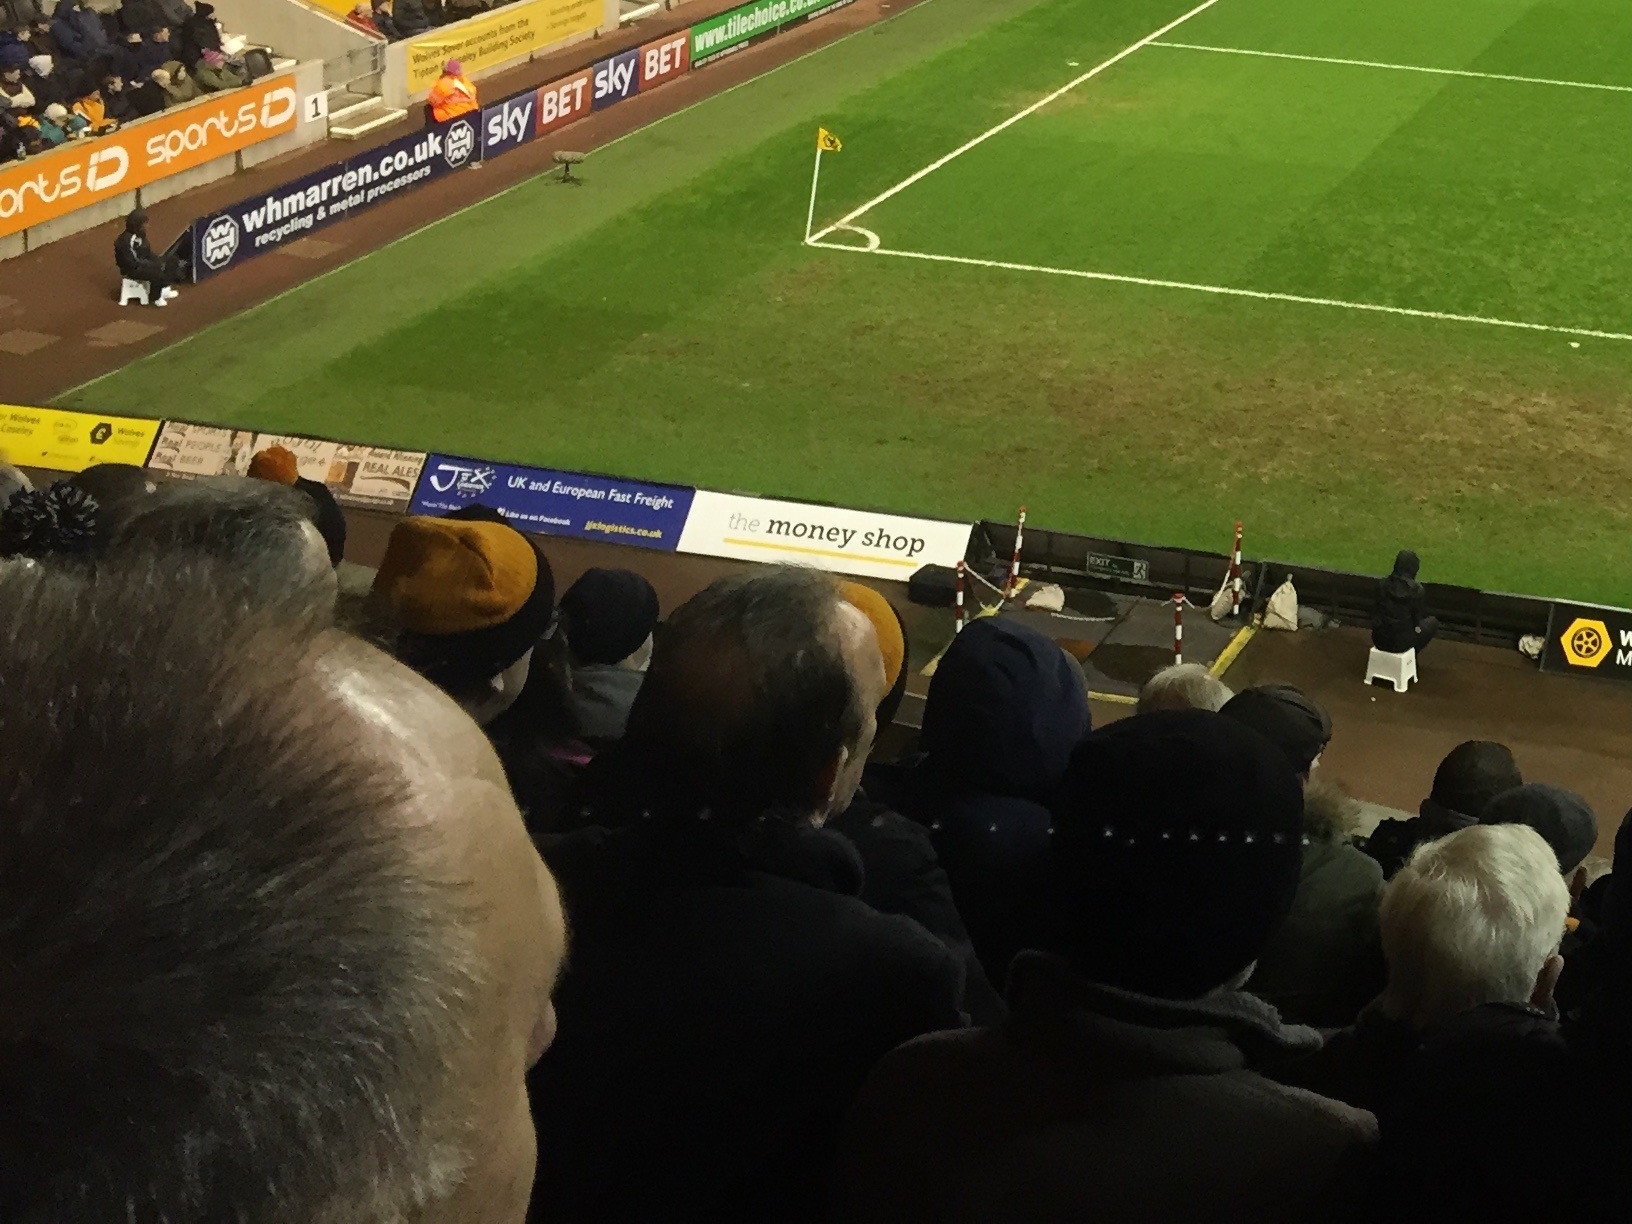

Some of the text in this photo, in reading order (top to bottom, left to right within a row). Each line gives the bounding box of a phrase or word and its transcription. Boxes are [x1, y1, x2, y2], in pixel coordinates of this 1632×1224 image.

[310, 98, 321, 118] 1
[487, 101, 533, 148] sky
[541, 77, 588, 125] BET
[594, 57, 636, 100] sky
[643, 36, 686, 81] BET
[242, 132, 442, 233] whmarren.co.uk
[255, 165, 431, 248] recycling & metal processors
[362, 461, 420, 478] REAL ALES
[508, 476, 674, 511] UK and European Fast Freight
[539, 515, 571, 526] Facebook
[729, 513, 925, 557] the money shop
